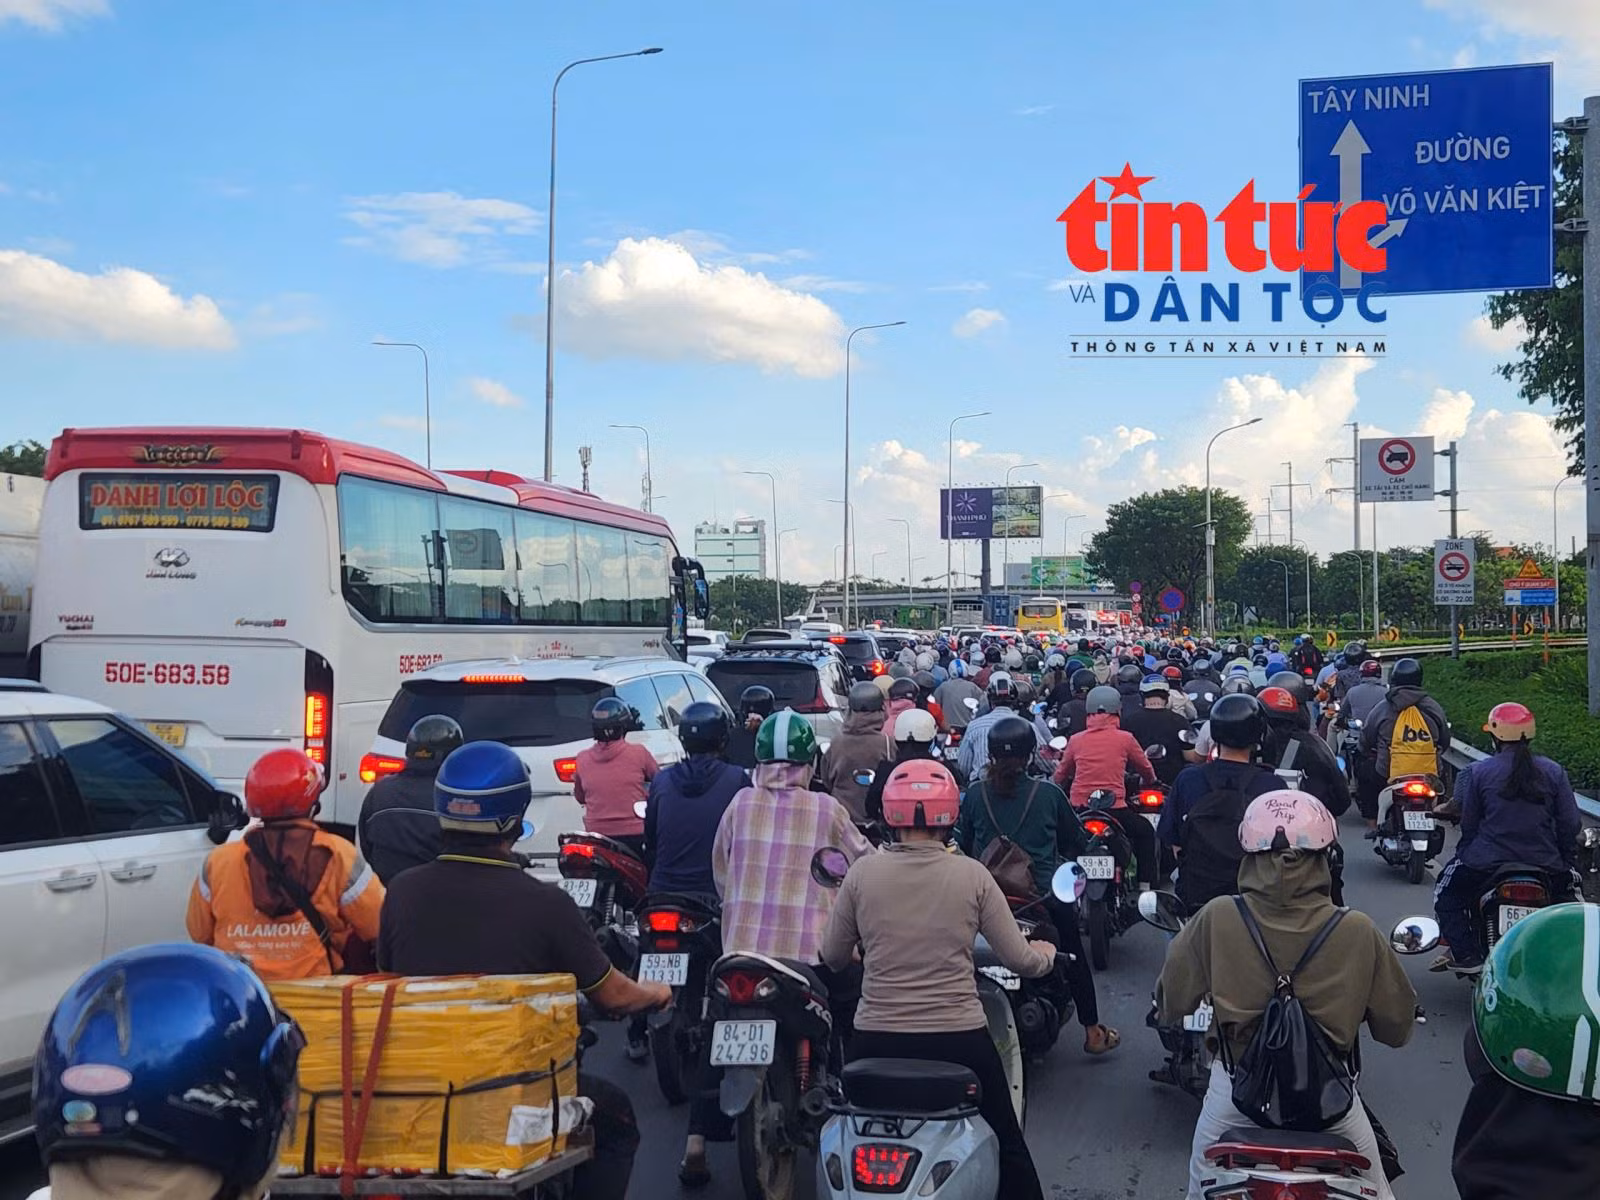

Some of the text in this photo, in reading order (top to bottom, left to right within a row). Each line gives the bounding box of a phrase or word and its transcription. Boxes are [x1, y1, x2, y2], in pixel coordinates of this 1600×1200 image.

[1308, 84, 1430, 114] TÂY NINH
[1415, 132, 1510, 164] ĐƯỜNG
[1382, 180, 1546, 216] VÕ VĂN KIỆT
[91, 480, 265, 514] DANH LỢI LỘC
[1445, 541, 1464, 551] ZONE
[105, 662, 230, 685] 50E-683.58
[1402, 724, 1431, 742] be
[1271, 807, 1295, 824] Trip
[227, 922, 311, 937] LALAMOVE
[723, 1024, 764, 1041] 84-D1
[715, 1043, 769, 1062] 247.96
